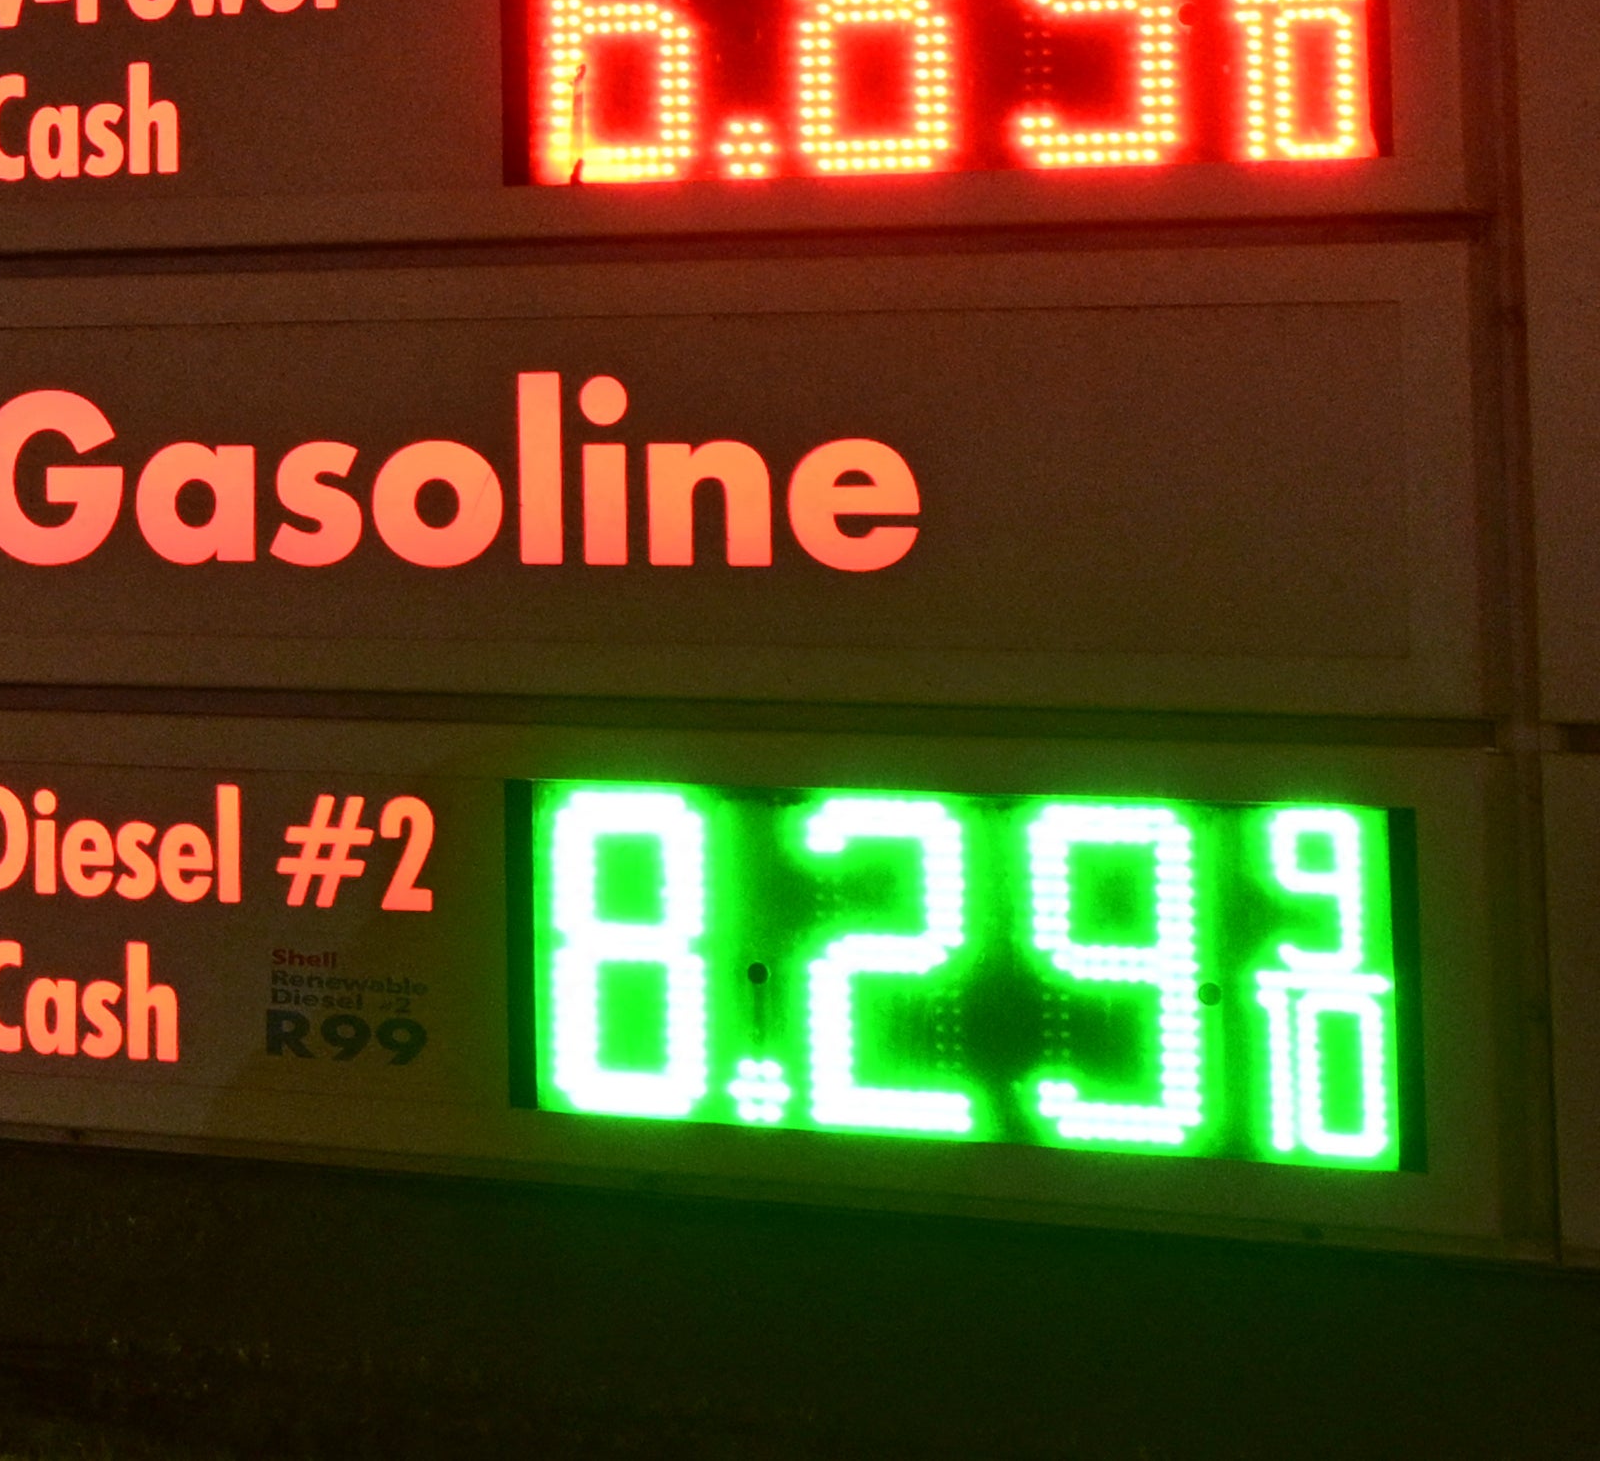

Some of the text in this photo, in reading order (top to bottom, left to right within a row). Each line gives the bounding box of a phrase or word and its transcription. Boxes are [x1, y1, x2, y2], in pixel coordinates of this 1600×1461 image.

[1242, 8, 1365, 162] 10
[276, 794, 435, 912] #2
[1265, 806, 1367, 977] 9
[271, 949, 337, 968] Shell
[271, 970, 428, 995] Renewable
[271, 989, 363, 1011] Diesel
[549, 788, 1204, 1146] 8.29
[267, 1009, 428, 1066] R99
[1256, 991, 1393, 1160] 10
